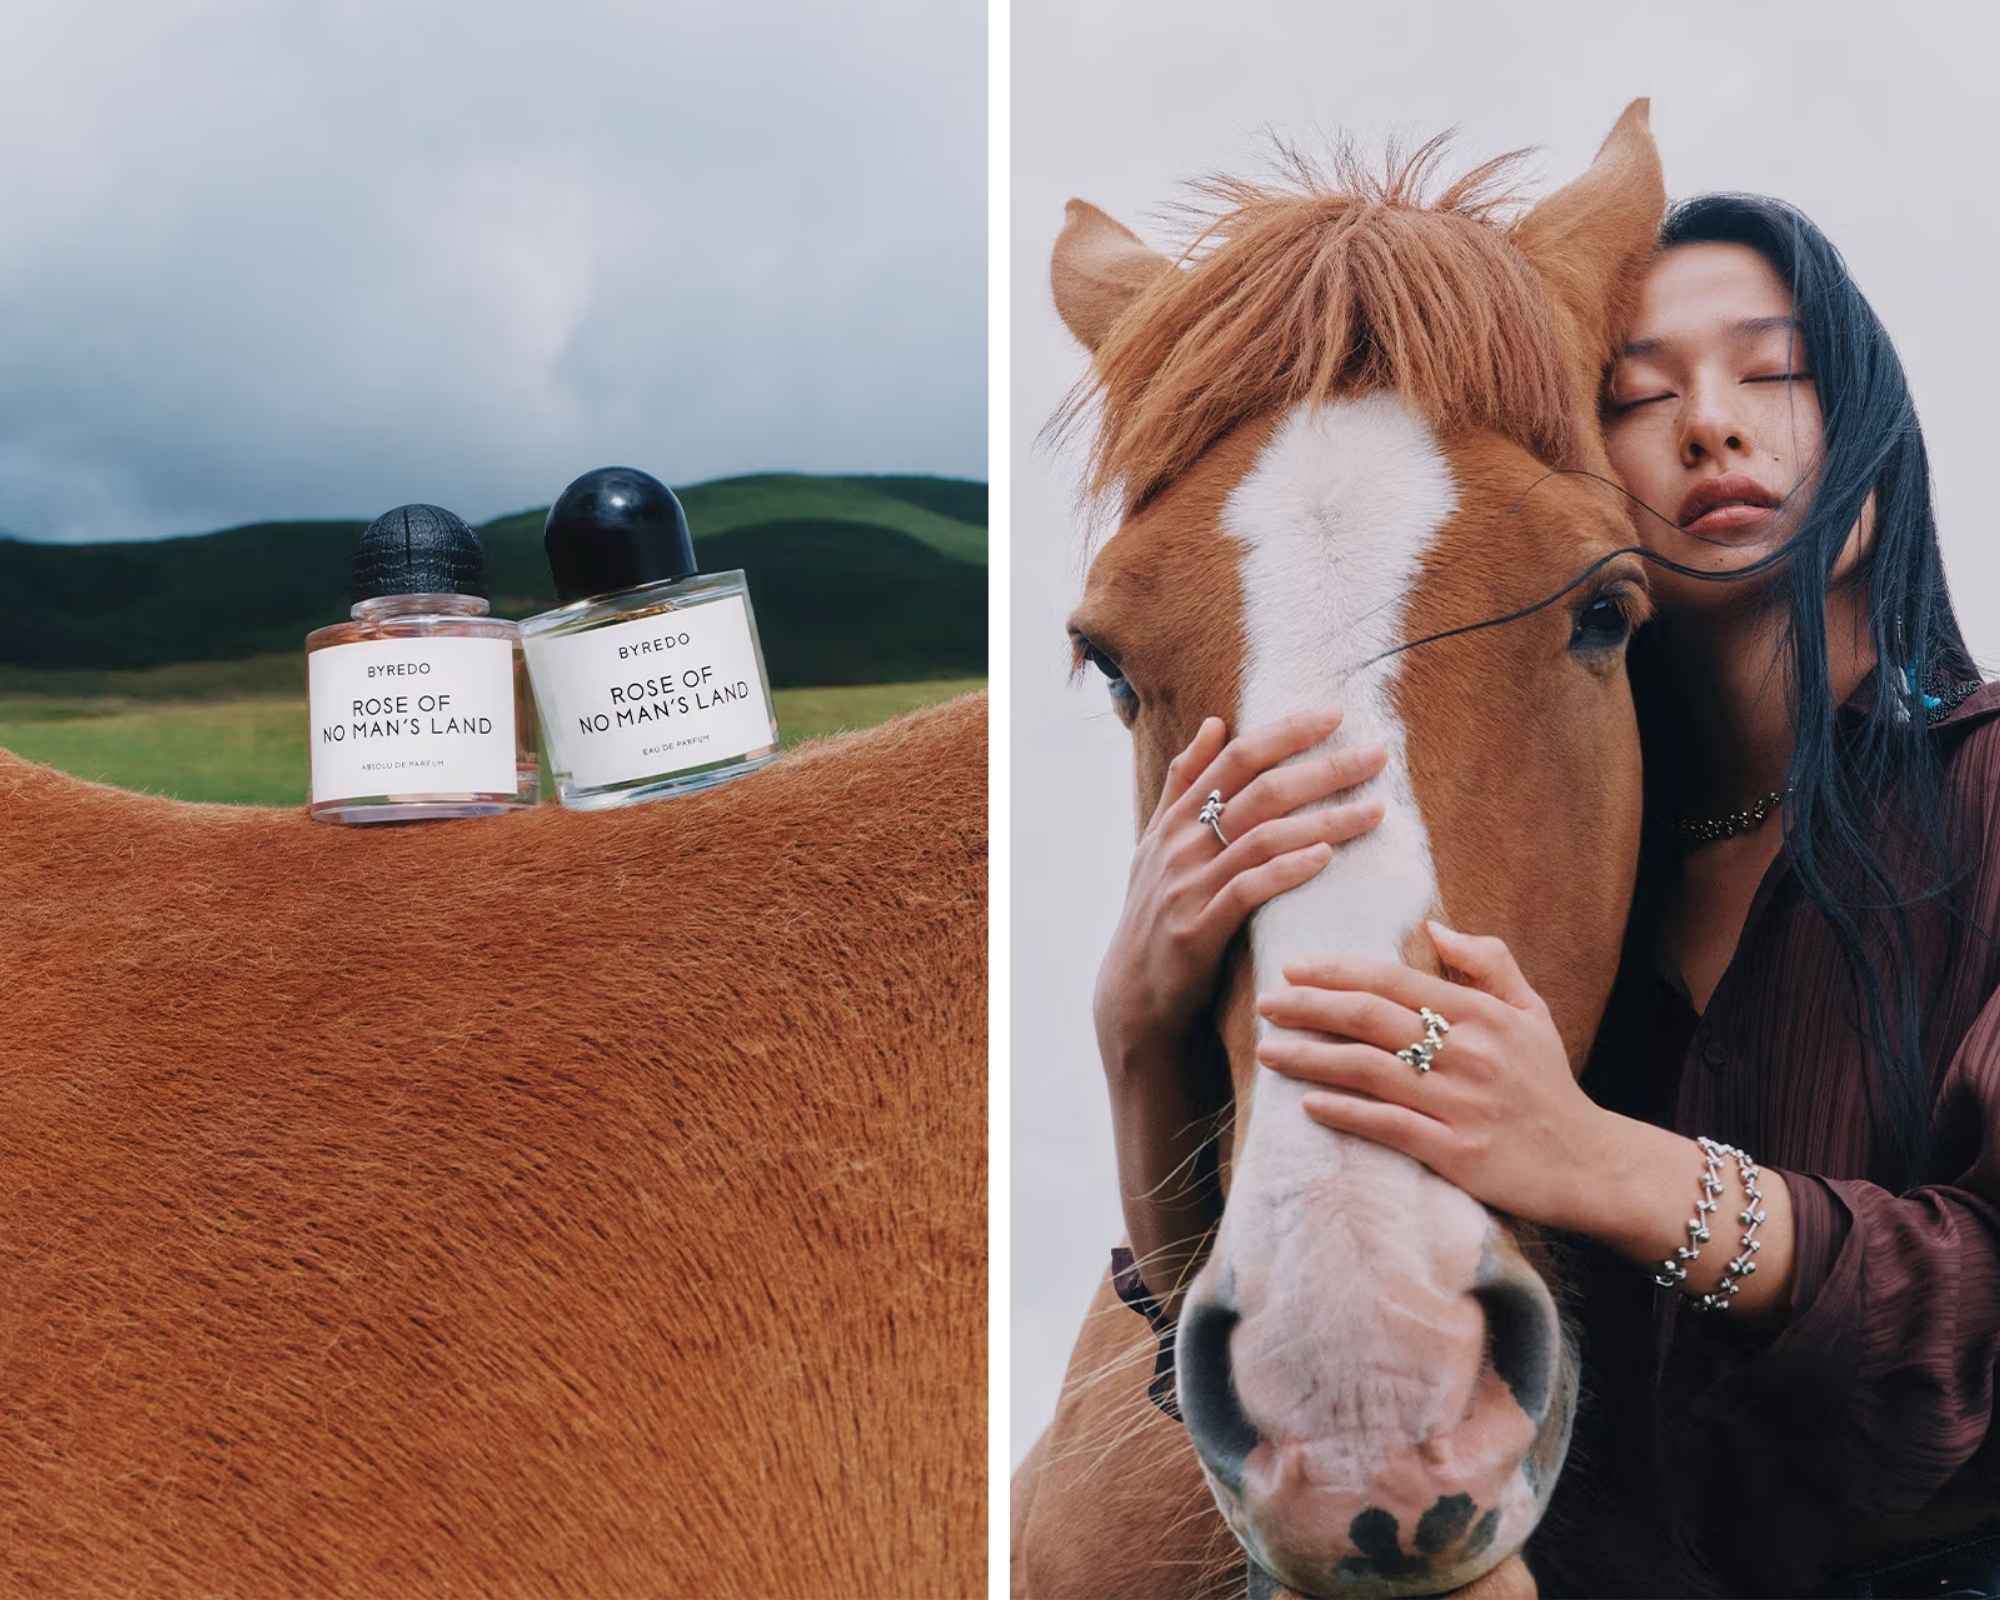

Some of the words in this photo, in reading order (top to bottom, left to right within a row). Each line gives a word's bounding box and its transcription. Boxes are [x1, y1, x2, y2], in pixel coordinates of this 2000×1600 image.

[619, 633, 690, 659] BYREDO
[367, 662, 431, 678] BYREDO
[611, 675, 675, 704] ROSE
[682, 665, 713, 688] OF
[352, 695, 408, 717] ROSE
[418, 694, 450, 712] OF
[579, 714, 610, 735] NO
[616, 696, 690, 728] MAN'S
[696, 681, 750, 710] LAND
[324, 724, 346, 744] NO
[353, 718, 421, 739] MAN'S
[431, 717, 493, 735] LAND
[642, 746, 661, 756] EAU
[662, 742, 674, 752] DE
[676, 734, 710, 747] PARFUM
[361, 762, 393, 771] ABSOLU
[395, 761, 407, 769] DE
[409, 759, 444, 768] PARFUM
